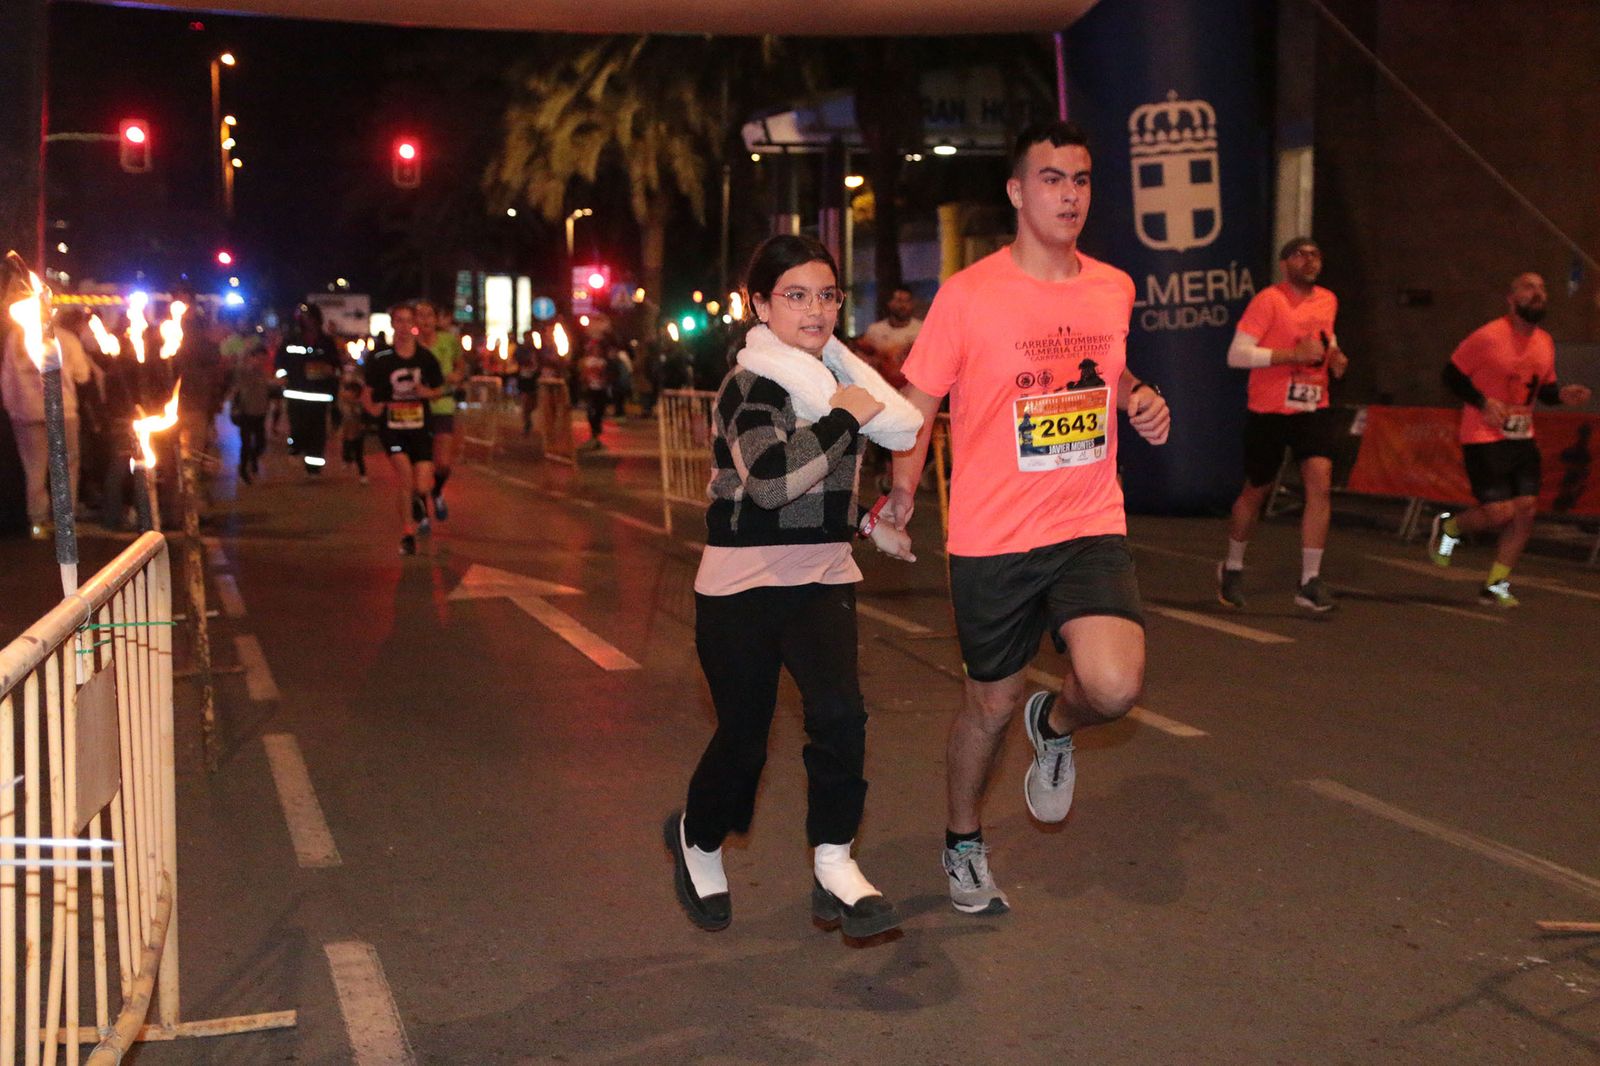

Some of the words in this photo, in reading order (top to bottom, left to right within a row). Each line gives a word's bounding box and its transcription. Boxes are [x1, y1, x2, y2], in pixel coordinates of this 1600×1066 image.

[1140, 304, 1230, 331] CIUDAD
[1015, 338, 1061, 350] CARRERA
[1040, 413, 1098, 438] 2643
[1049, 443, 1070, 455] JAVIER
